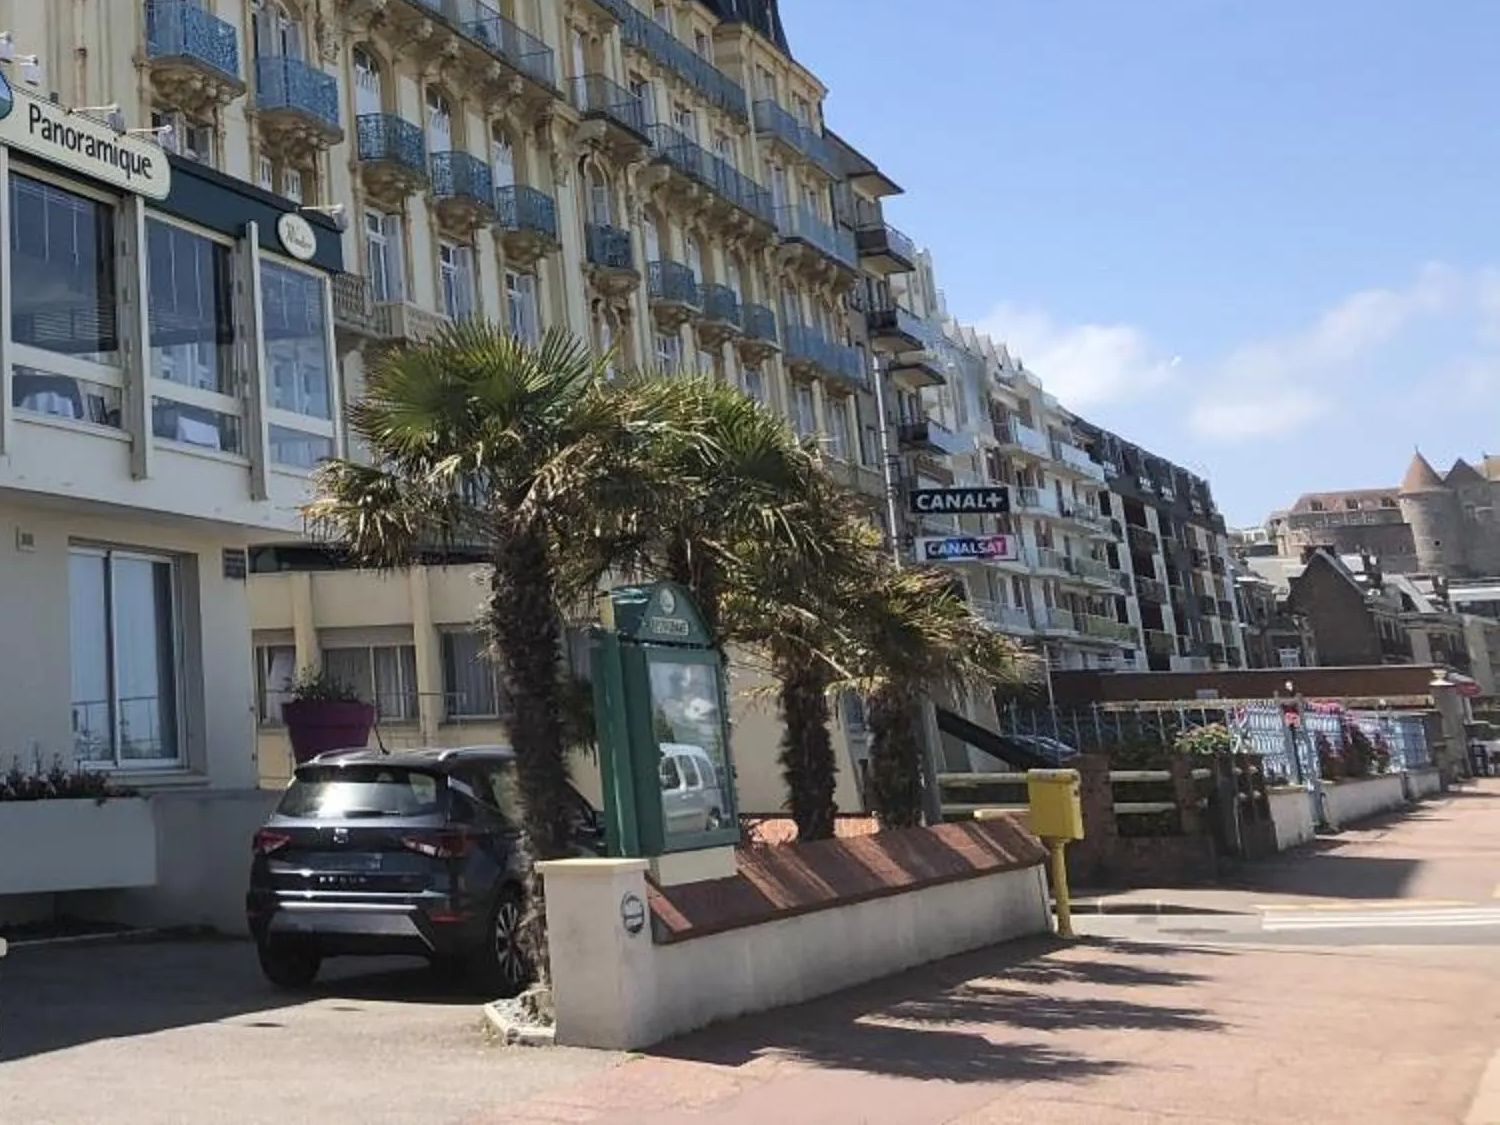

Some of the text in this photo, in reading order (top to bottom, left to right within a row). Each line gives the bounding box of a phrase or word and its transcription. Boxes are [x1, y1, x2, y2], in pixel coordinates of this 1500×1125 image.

[28, 103, 153, 179] Panoramique
[916, 492, 1002, 510] CANAL+
[927, 539, 1006, 555] CANALSAT
